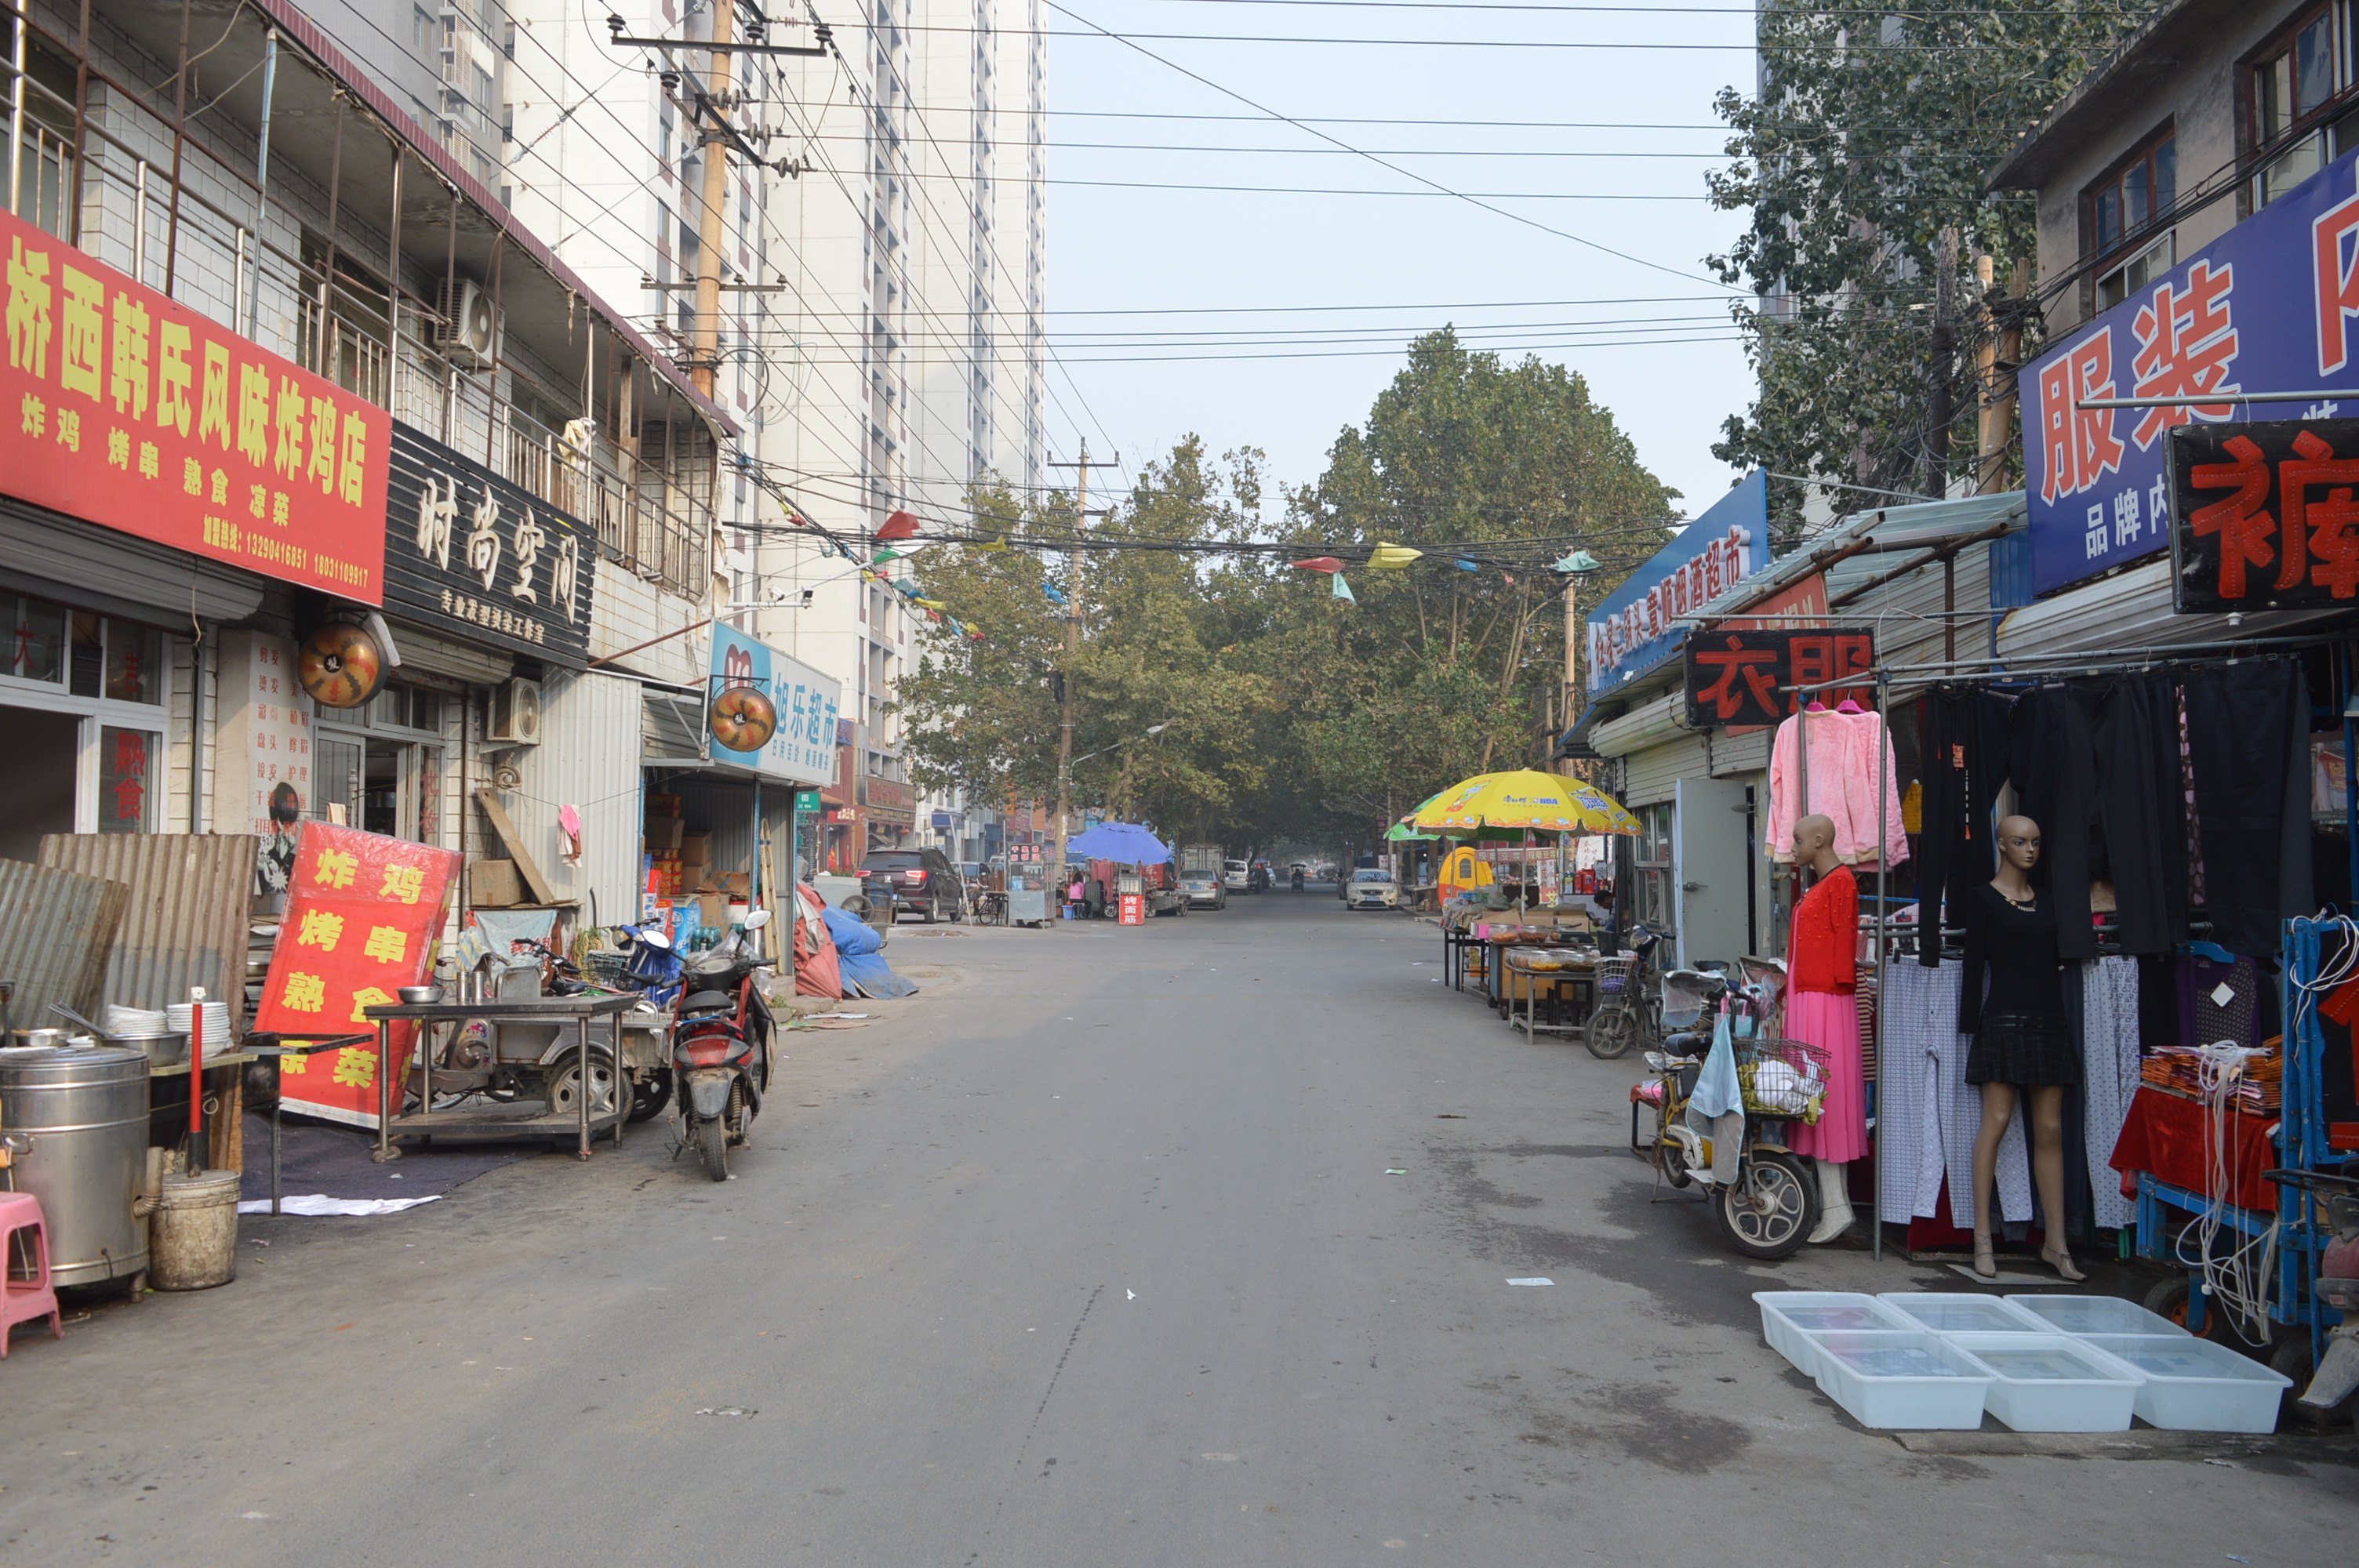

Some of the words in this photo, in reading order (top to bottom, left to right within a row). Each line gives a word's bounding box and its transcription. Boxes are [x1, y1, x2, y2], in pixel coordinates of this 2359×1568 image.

[7, 234, 367, 508] 桥西韩氏风味炸鸡店
[2040, 259, 2242, 506] 服装
[21, 392, 80, 452] 炸鸡
[108, 426, 159, 481] 烤串
[184, 456, 229, 506] 熟食
[249, 483, 289, 527] 凉菜
[246, 531, 307, 570] 13290416851
[314, 553, 369, 588] 18031109917
[416, 473, 577, 625] 时尚空间
[775, 672, 838, 750] 旭乐超市
[1696, 635, 1874, 719] 衣服
[113, 731, 146, 820] 熟食
[314, 848, 427, 905] 炸鸡
[1124, 895, 1138, 924] 烤面筋
[297, 909, 408, 964] 烤串
[282, 971, 394, 1028] 熟食
